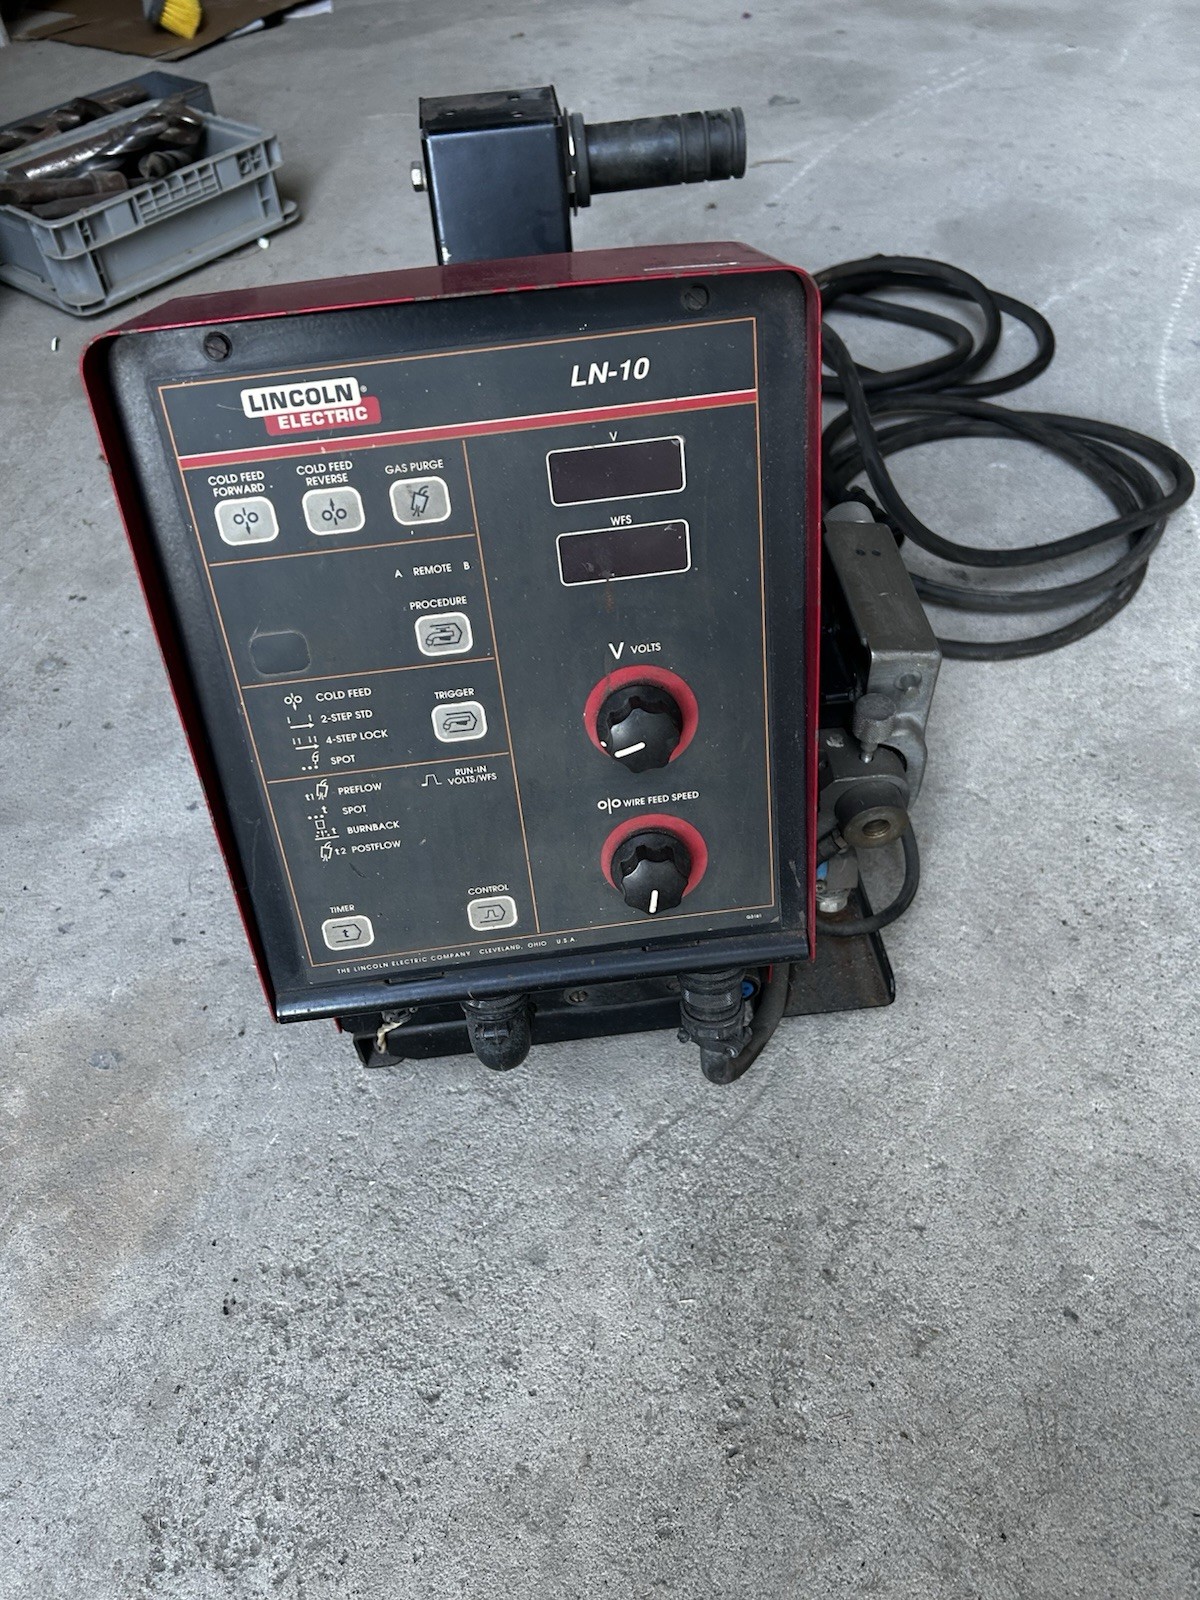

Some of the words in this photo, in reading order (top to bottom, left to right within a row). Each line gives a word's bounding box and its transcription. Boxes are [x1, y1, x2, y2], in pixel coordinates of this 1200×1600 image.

[571, 357, 650, 387] LN-10
[248, 383, 354, 412] LINCOLN
[277, 406, 369, 430] ELECTRIC
[609, 431, 617, 442] V
[296, 463, 327, 476] COLD
[330, 460, 353, 472] FEED
[384, 463, 407, 475] GAS
[409, 458, 444, 472] PURGE
[207, 474, 238, 487] COLD
[240, 470, 265, 484] FEED
[305, 472, 349, 487] REVERSE
[213, 482, 265, 498] FORWARD
[610, 514, 633, 526] WFS
[394, 569, 403, 579] A
[412, 562, 452, 577] REMOTE
[463, 560, 471, 571] B
[409, 595, 468, 611] PROCEDURE
[608, 641, 624, 660] V
[630, 642, 661, 654] VOLTS
[315, 691, 346, 703] COLD
[347, 687, 372, 700] FEED
[434, 687, 475, 700] TRIGGER
[320, 711, 354, 724] 2-STEP
[355, 709, 373, 722] STD
[325, 732, 358, 746] 4-STEP
[359, 728, 389, 743] LOCK
[330, 754, 356, 766] SPOT
[448, 772, 498, 786] VOLTS/WFS
[454, 765, 487, 777] RUN-IN
[337, 782, 383, 796] PREFLOW
[622, 796, 646, 808] WIRE
[647, 794, 670, 804] FEED
[671, 790, 700, 802] SPEED
[342, 804, 368, 816] SPOT
[346, 820, 400, 836] BURNBACK
[351, 839, 402, 855] POSTFLOW
[467, 884, 510, 896] CONTROL
[329, 904, 355, 914] TIMER
[353, 961, 389, 973] LINCOLN
[391, 956, 428, 967] ELECTRIC
[430, 950, 471, 962] COMPANY
[527, 939, 548, 949] OHIO
